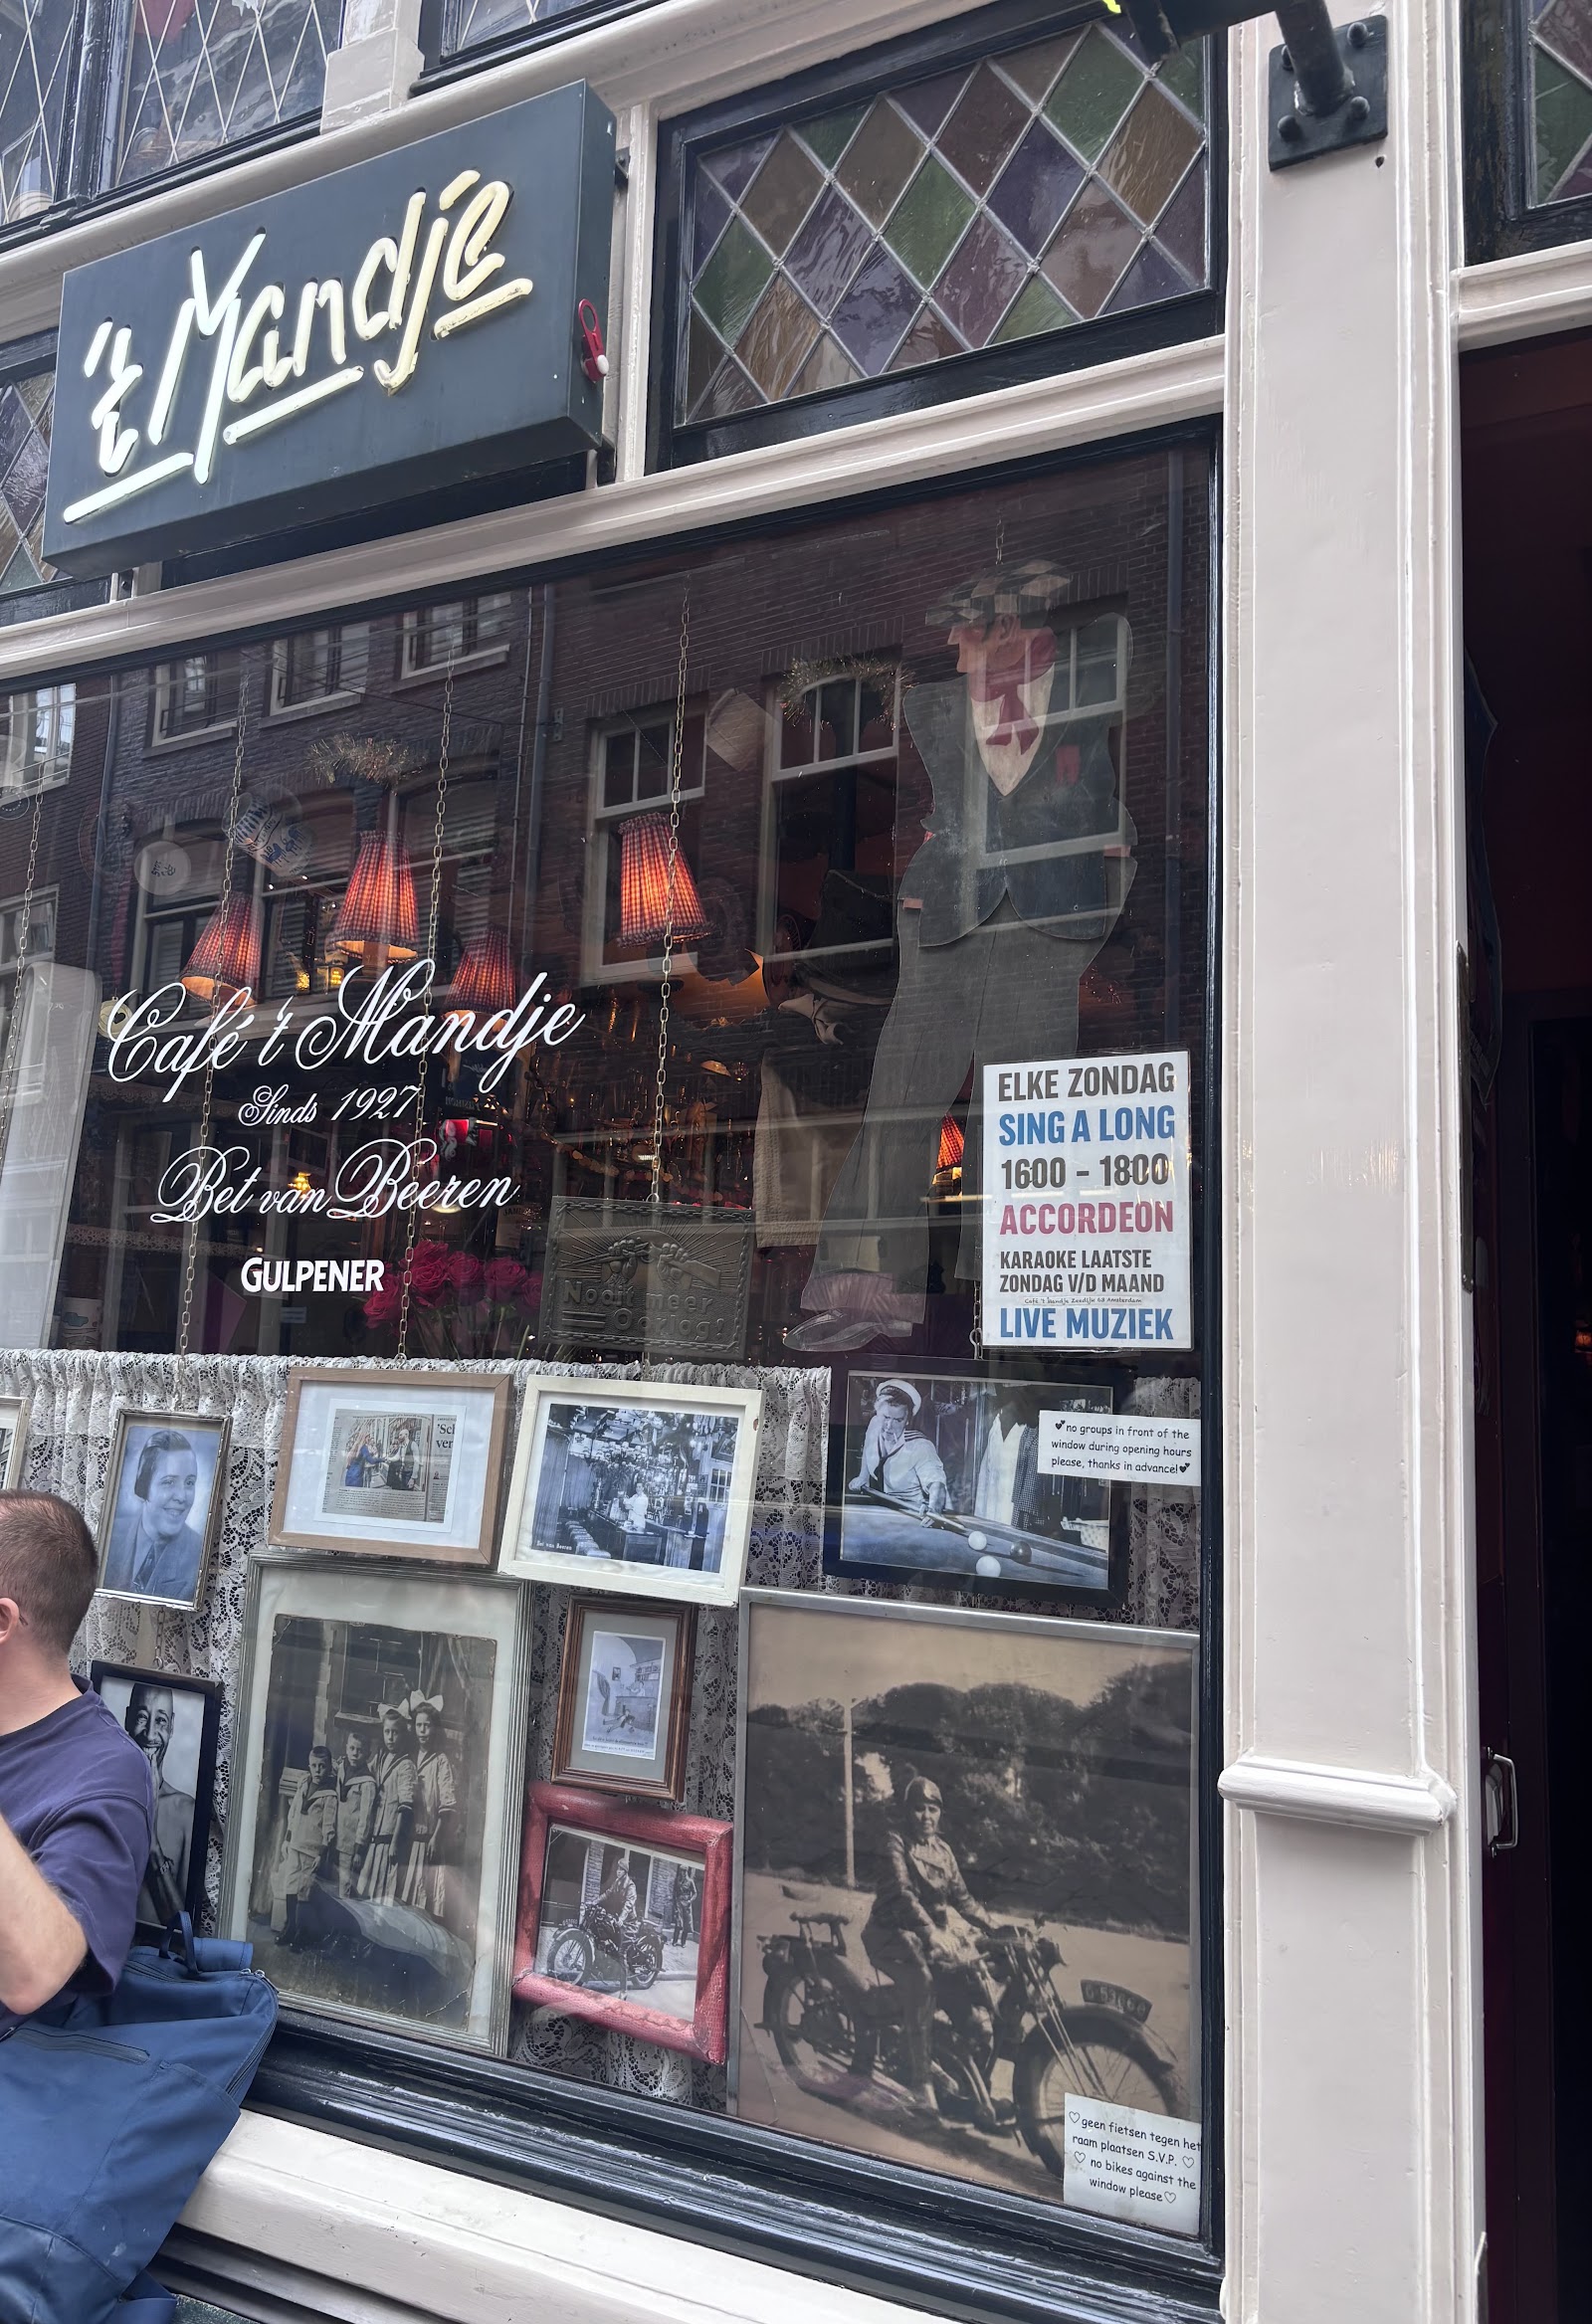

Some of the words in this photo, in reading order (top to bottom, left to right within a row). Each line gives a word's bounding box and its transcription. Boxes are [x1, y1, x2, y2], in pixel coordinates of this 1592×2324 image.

[148, 169, 512, 484] Mandje
[106, 982, 254, 1102] Café
[295, 958, 585, 1093] Mandje
[998, 1069, 1059, 1101] ELKE
[1068, 1062, 1175, 1099] ZONDAG
[238, 1084, 318, 1127] Sinds
[330, 1084, 421, 1121] 1927
[999, 1110, 1065, 1146] SING
[1071, 1109, 1093, 1143] A
[1099, 1105, 1175, 1141] LONG
[149, 1145, 255, 1225] Bet
[259, 1185, 332, 1216] van
[325, 1138, 521, 1221] Beeren
[1001, 1156, 1066, 1190] 1600
[1099, 1153, 1170, 1187] 1800
[999, 1200, 1174, 1236] ACCORDEON
[241, 1258, 385, 1292] GULPENER
[1000, 1250, 1077, 1269] KARAOKE
[1082, 1249, 1152, 1268] LAATSTE
[563, 1279, 635, 1307] Nooit
[646, 1292, 712, 1314] meer
[999, 1273, 1063, 1293] ZONDAG
[1068, 1272, 1096, 1293] V/D
[1101, 1273, 1165, 1293] MAAND
[1000, 1307, 1057, 1339] LIVE
[1066, 1307, 1174, 1340] MUZIEK
[1051, 1439, 1086, 1452] window
[1088, 1441, 1119, 1454] during
[1122, 1444, 1160, 1457] opening
[1162, 1446, 1192, 1457] hours
[1066, 1424, 1078, 1433] no
[1080, 1425, 1112, 1437] groups
[1115, 1426, 1124, 1436] in
[1126, 1426, 1154, 1438] front
[1157, 1428, 1168, 1439] of
[1171, 1429, 1190, 1440] the
[1051, 1455, 1085, 1468] please,
[1088, 1458, 1120, 1470] thanks
[1123, 1460, 1133, 1471] in
[1135, 1462, 1178, 1474] advance!
[1073, 2135, 1097, 2149] raam
[1100, 2140, 1144, 2159] plaatsen
[1147, 2151, 1177, 2166] S.V.P.
[1082, 2117, 1105, 2131] geen
[1108, 2121, 1146, 2140] fietsen
[1149, 2132, 1180, 2147] tegen
[1183, 2137, 1201, 2151] het
[1090, 2177, 1126, 2194] window
[1129, 2186, 1163, 2202] please
[1091, 2158, 1102, 2168] no
[1105, 2160, 1133, 2176] bikes
[1135, 2169, 1174, 2185] against
[1177, 2177, 1196, 2190] the
